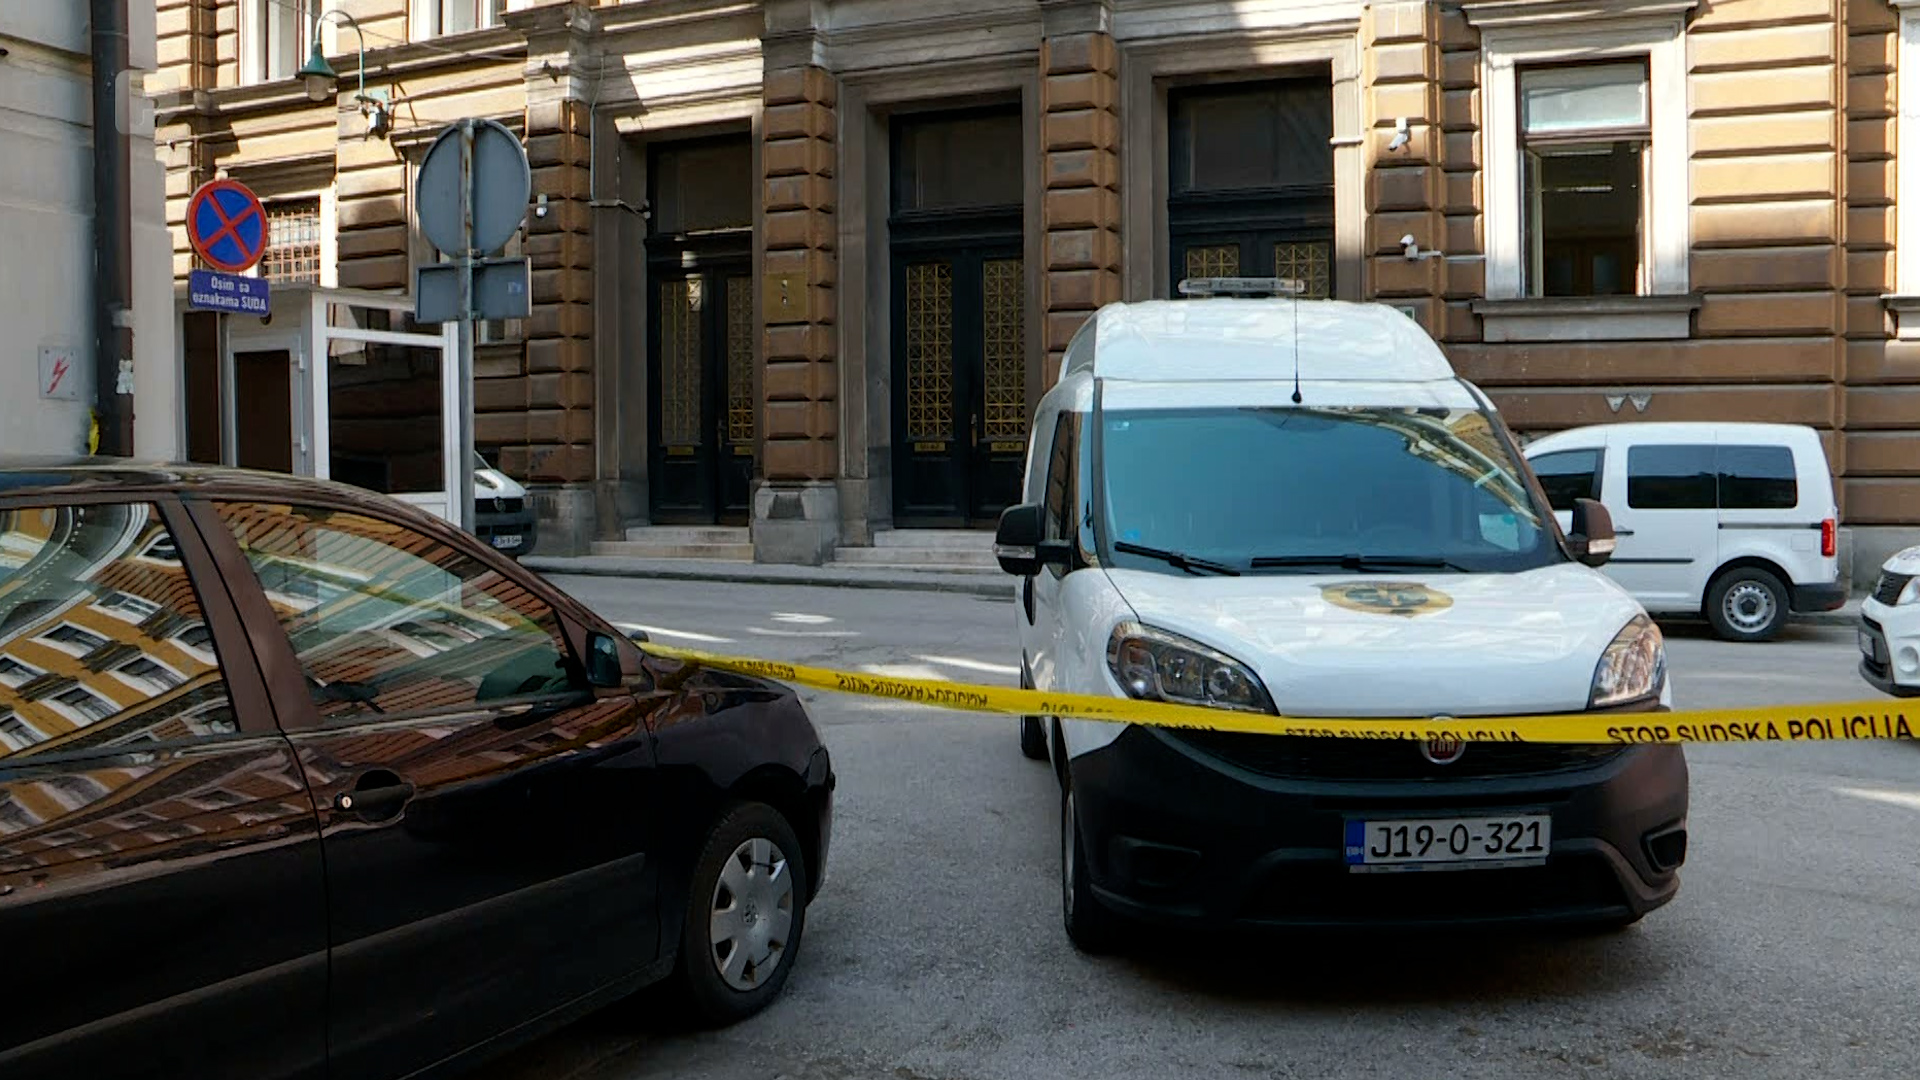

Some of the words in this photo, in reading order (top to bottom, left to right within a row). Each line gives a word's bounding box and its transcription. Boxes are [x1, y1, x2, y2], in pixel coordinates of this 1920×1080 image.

[211, 276, 234, 291] Osim
[239, 282, 250, 293] sa
[192, 292, 239, 307] oznakama
[241, 296, 266, 311] SUDA
[1607, 726, 1671, 743] STOP
[1676, 720, 1784, 742] SUDSKA
[1787, 713, 1915, 740] POLICIJA
